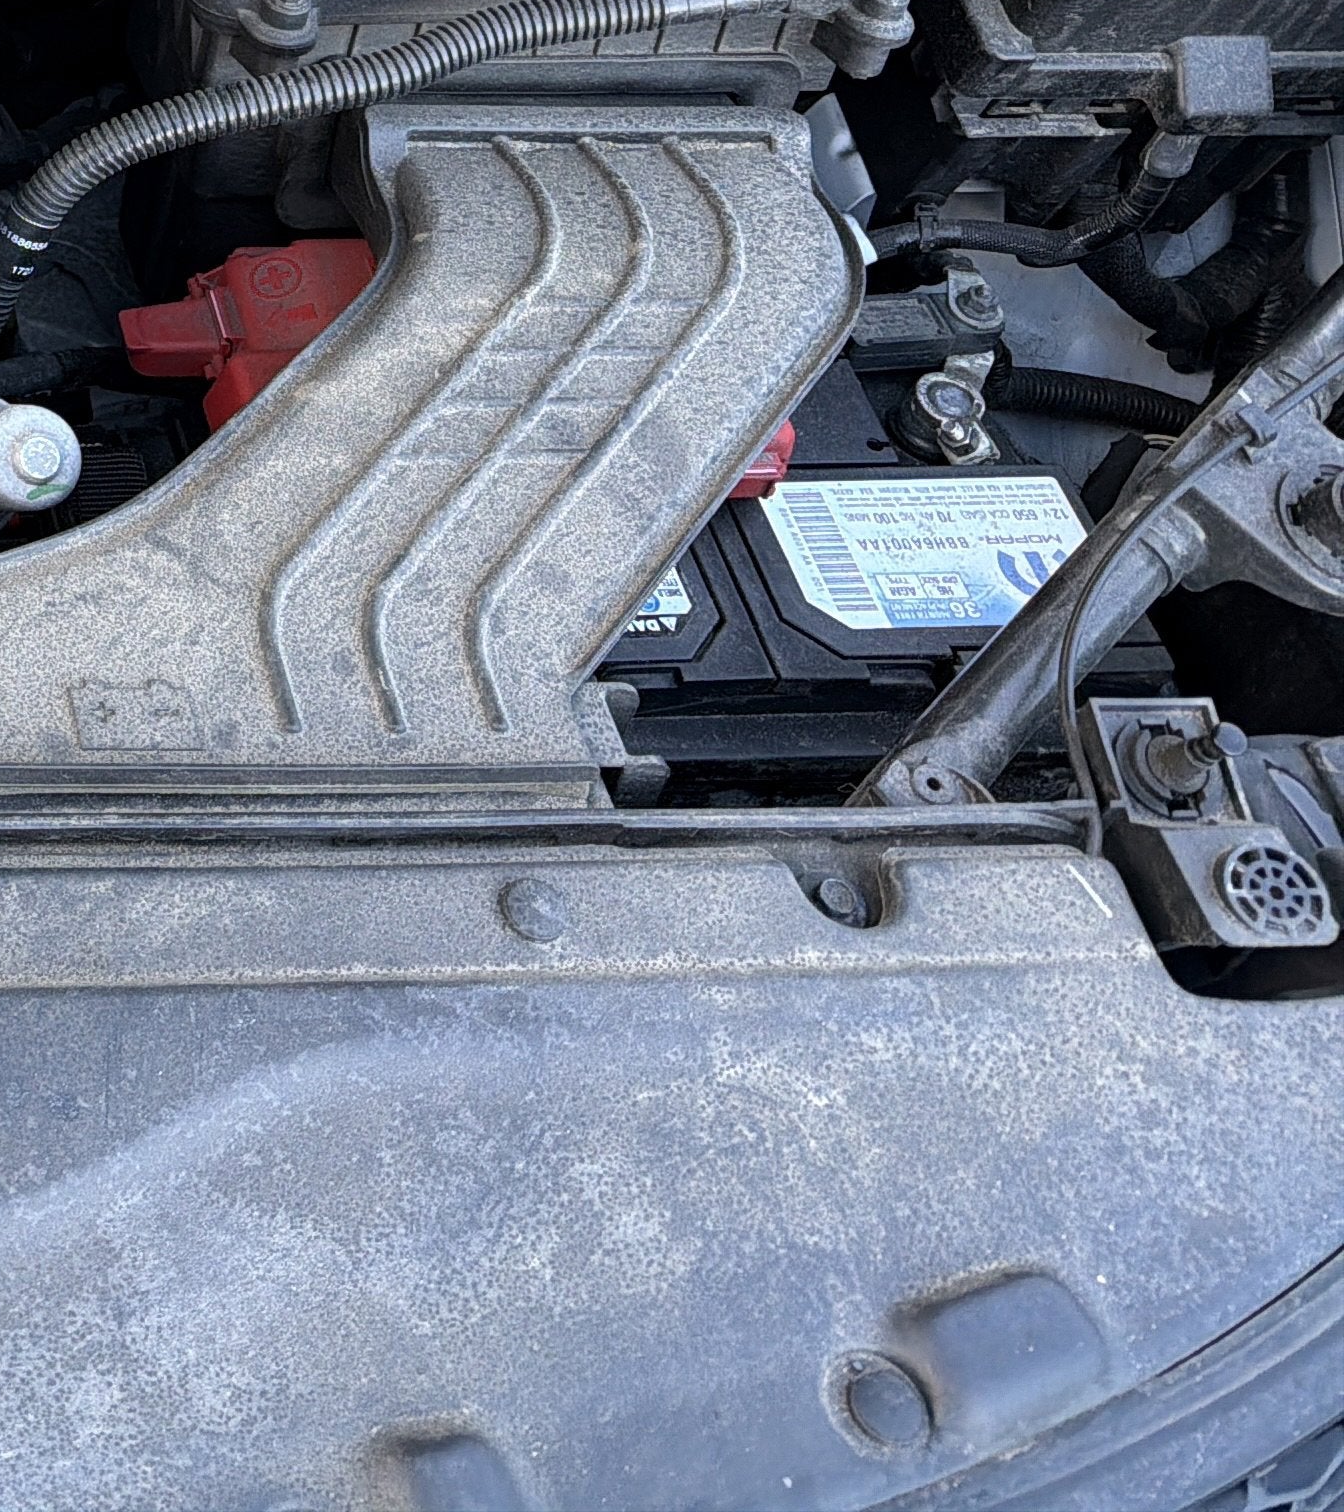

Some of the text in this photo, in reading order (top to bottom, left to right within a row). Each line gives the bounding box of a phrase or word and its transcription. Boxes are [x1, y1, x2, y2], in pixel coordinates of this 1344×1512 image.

[872, 512, 899, 524] 100
[1013, 509, 1038, 521] 650
[948, 600, 983, 620] 36
